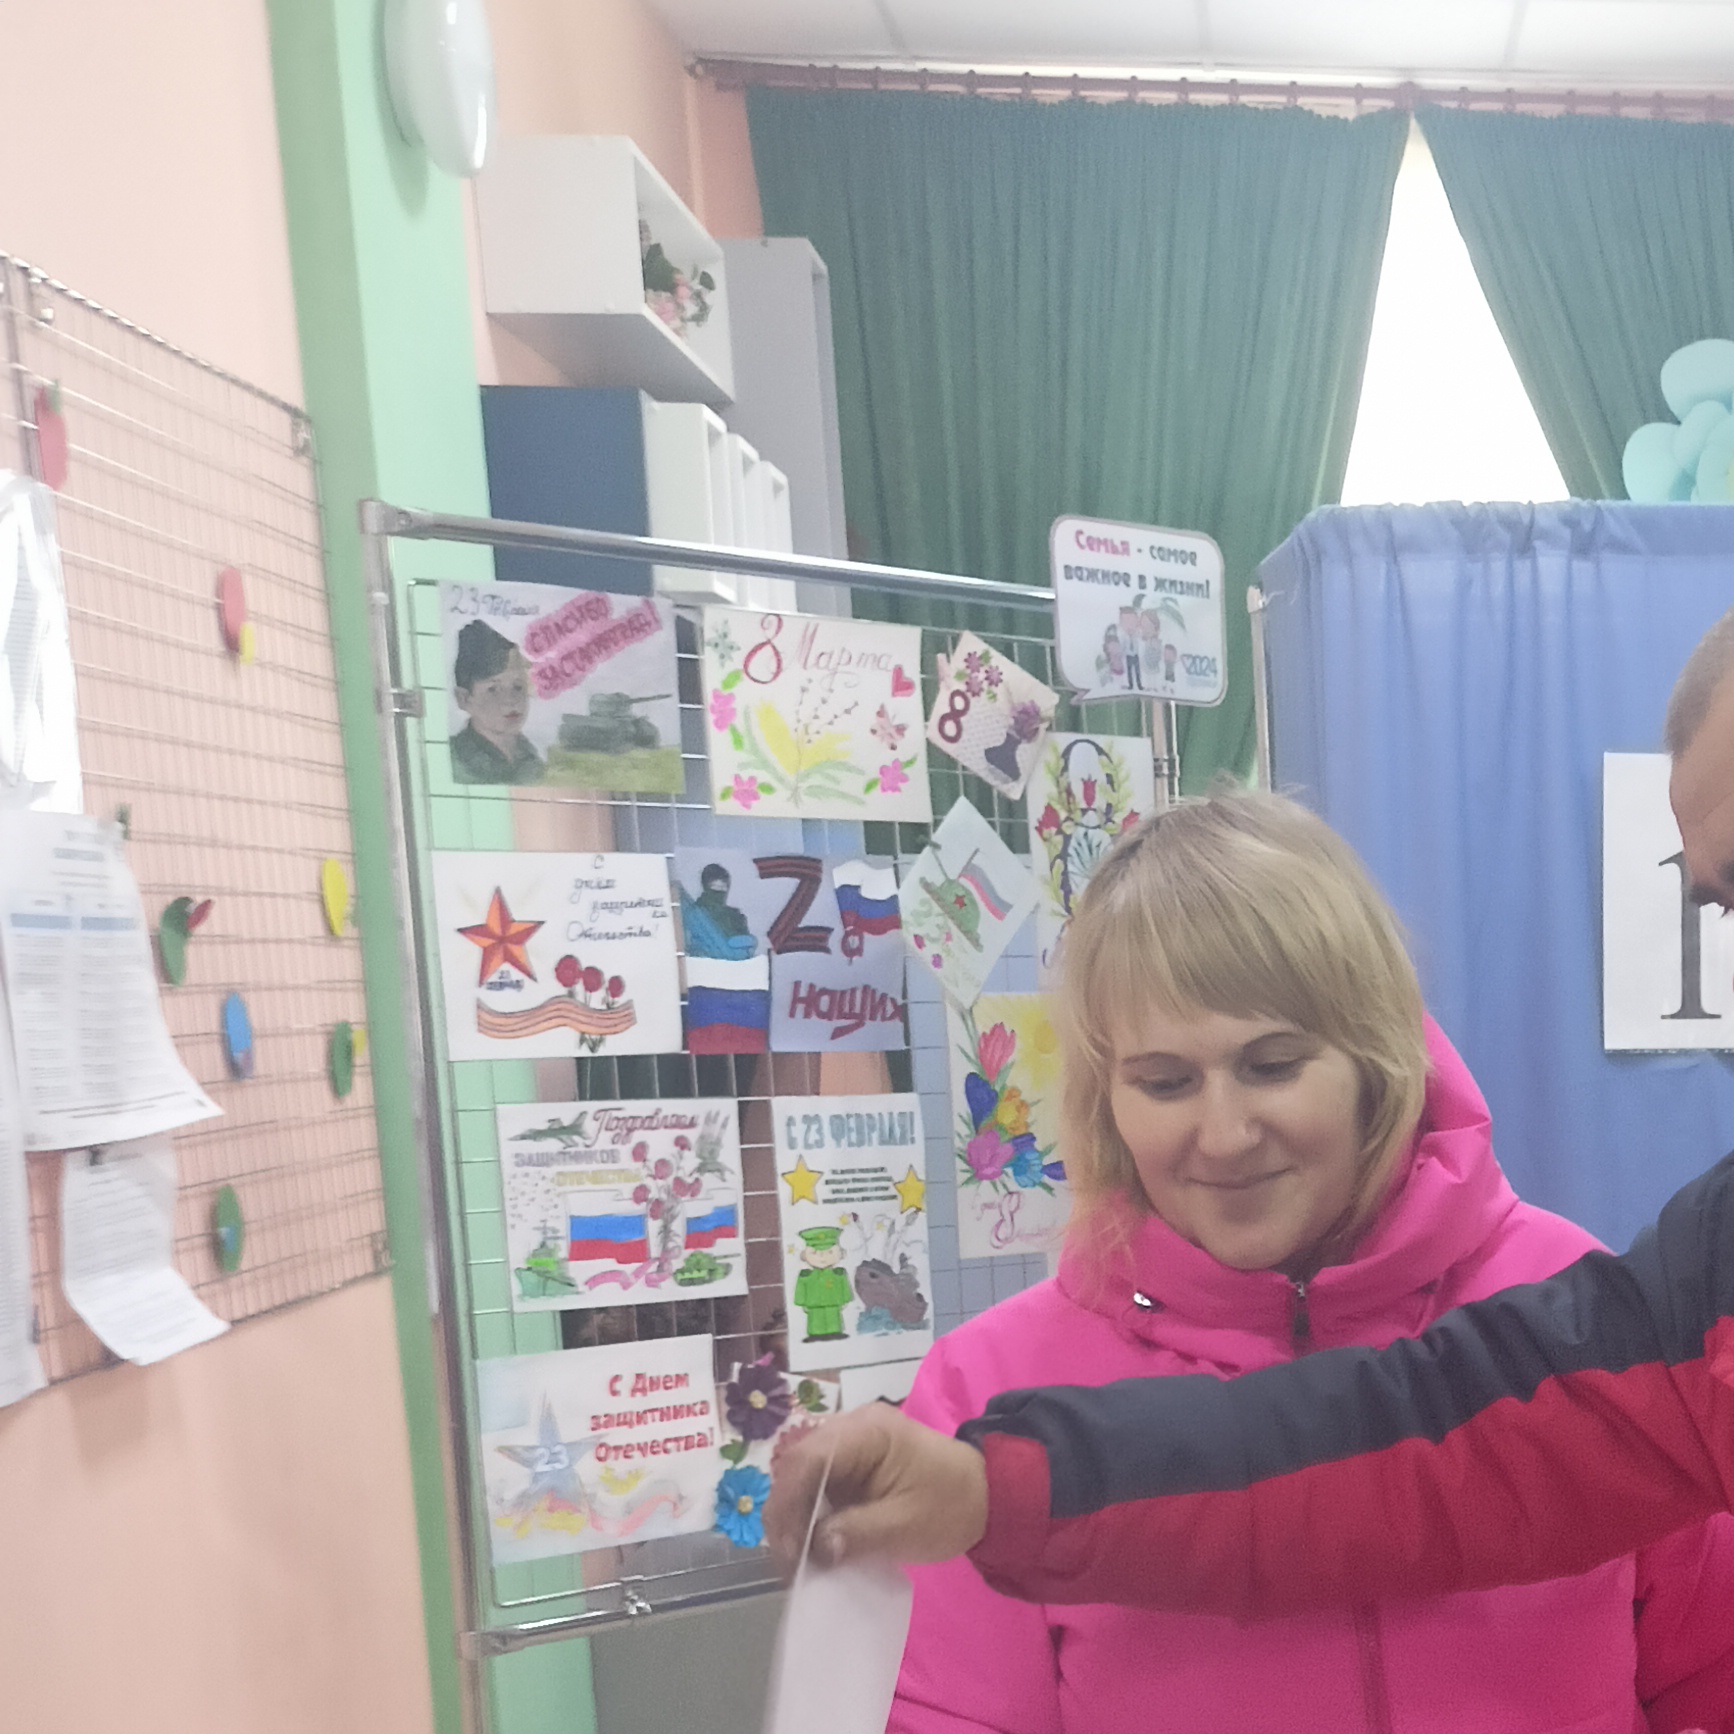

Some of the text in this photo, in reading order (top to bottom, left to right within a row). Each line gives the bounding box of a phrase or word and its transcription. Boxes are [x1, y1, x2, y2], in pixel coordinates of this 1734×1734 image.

[1075, 529, 1131, 557] Семья
[1149, 545, 1198, 567] самое
[450, 585, 480, 616] 23
[1063, 564, 1131, 588] важное
[1153, 576, 1211, 600] жизни!
[743, 613, 894, 693] 8 Марта
[938, 689, 971, 743] 8
[1658, 850, 1722, 1019] 1
[786, 1111, 916, 1150] С 23 ФЕВРАЛЯ!
[608, 1372, 690, 1398] С Днем
[590, 1400, 710, 1431] защитника
[535, 1443, 571, 1473] 23
[594, 1426, 715, 1463] Отечества!
